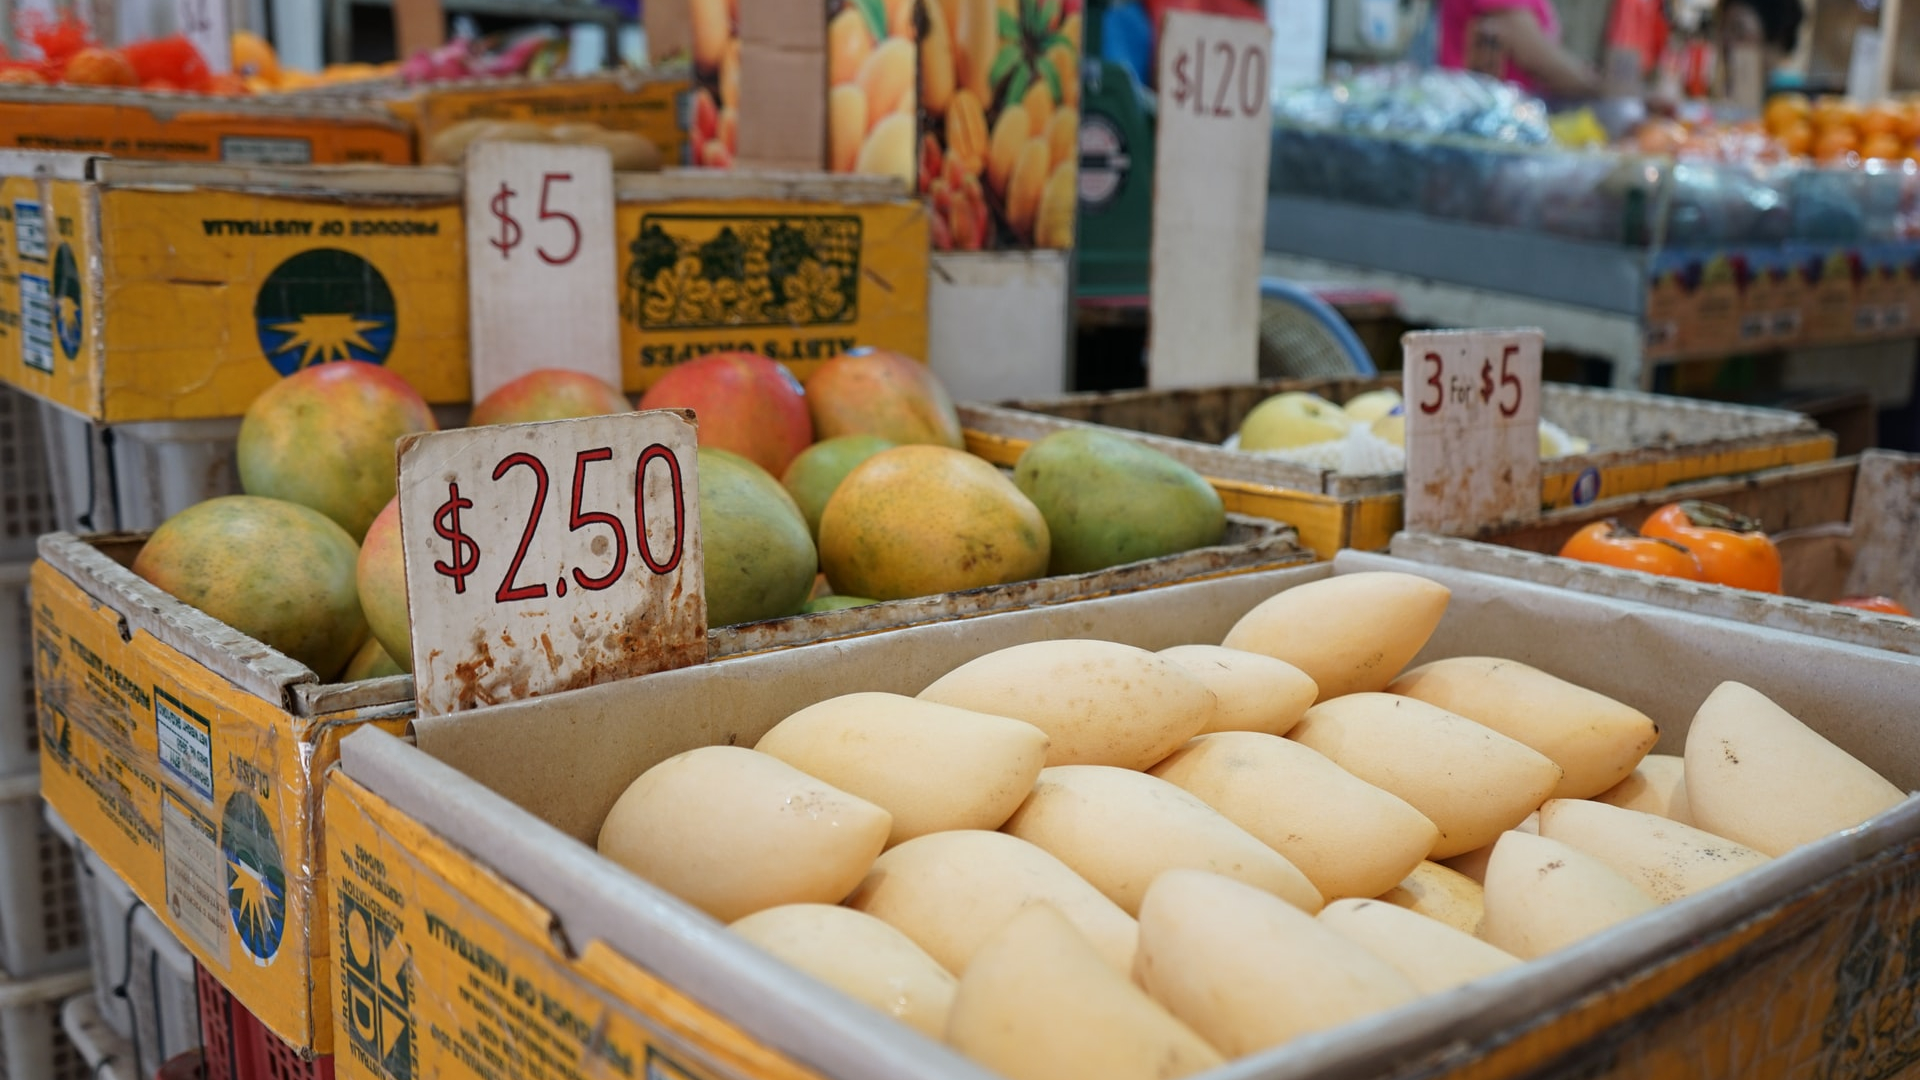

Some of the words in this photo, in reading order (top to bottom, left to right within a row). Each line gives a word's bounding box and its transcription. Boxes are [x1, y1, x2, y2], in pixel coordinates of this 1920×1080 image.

[202, 219, 313, 237] AUSTRALIA
[320, 219, 344, 236] OF
[350, 219, 438, 236] PRODUCE
[488, 172, 581, 266] $5
[1420, 351, 1443, 414] 3
[1480, 345, 1522, 418] $5
[433, 443, 685, 603] $2.50
[236, 755, 270, 800] CLASS
[342, 876, 404, 935] ACCREDITATION
[355, 860, 405, 910] CERTIFICATE
[337, 886, 350, 1034] PROGRAMME
[424, 909, 508, 988] AUSTRALIA
[514, 974, 536, 1007] OF
